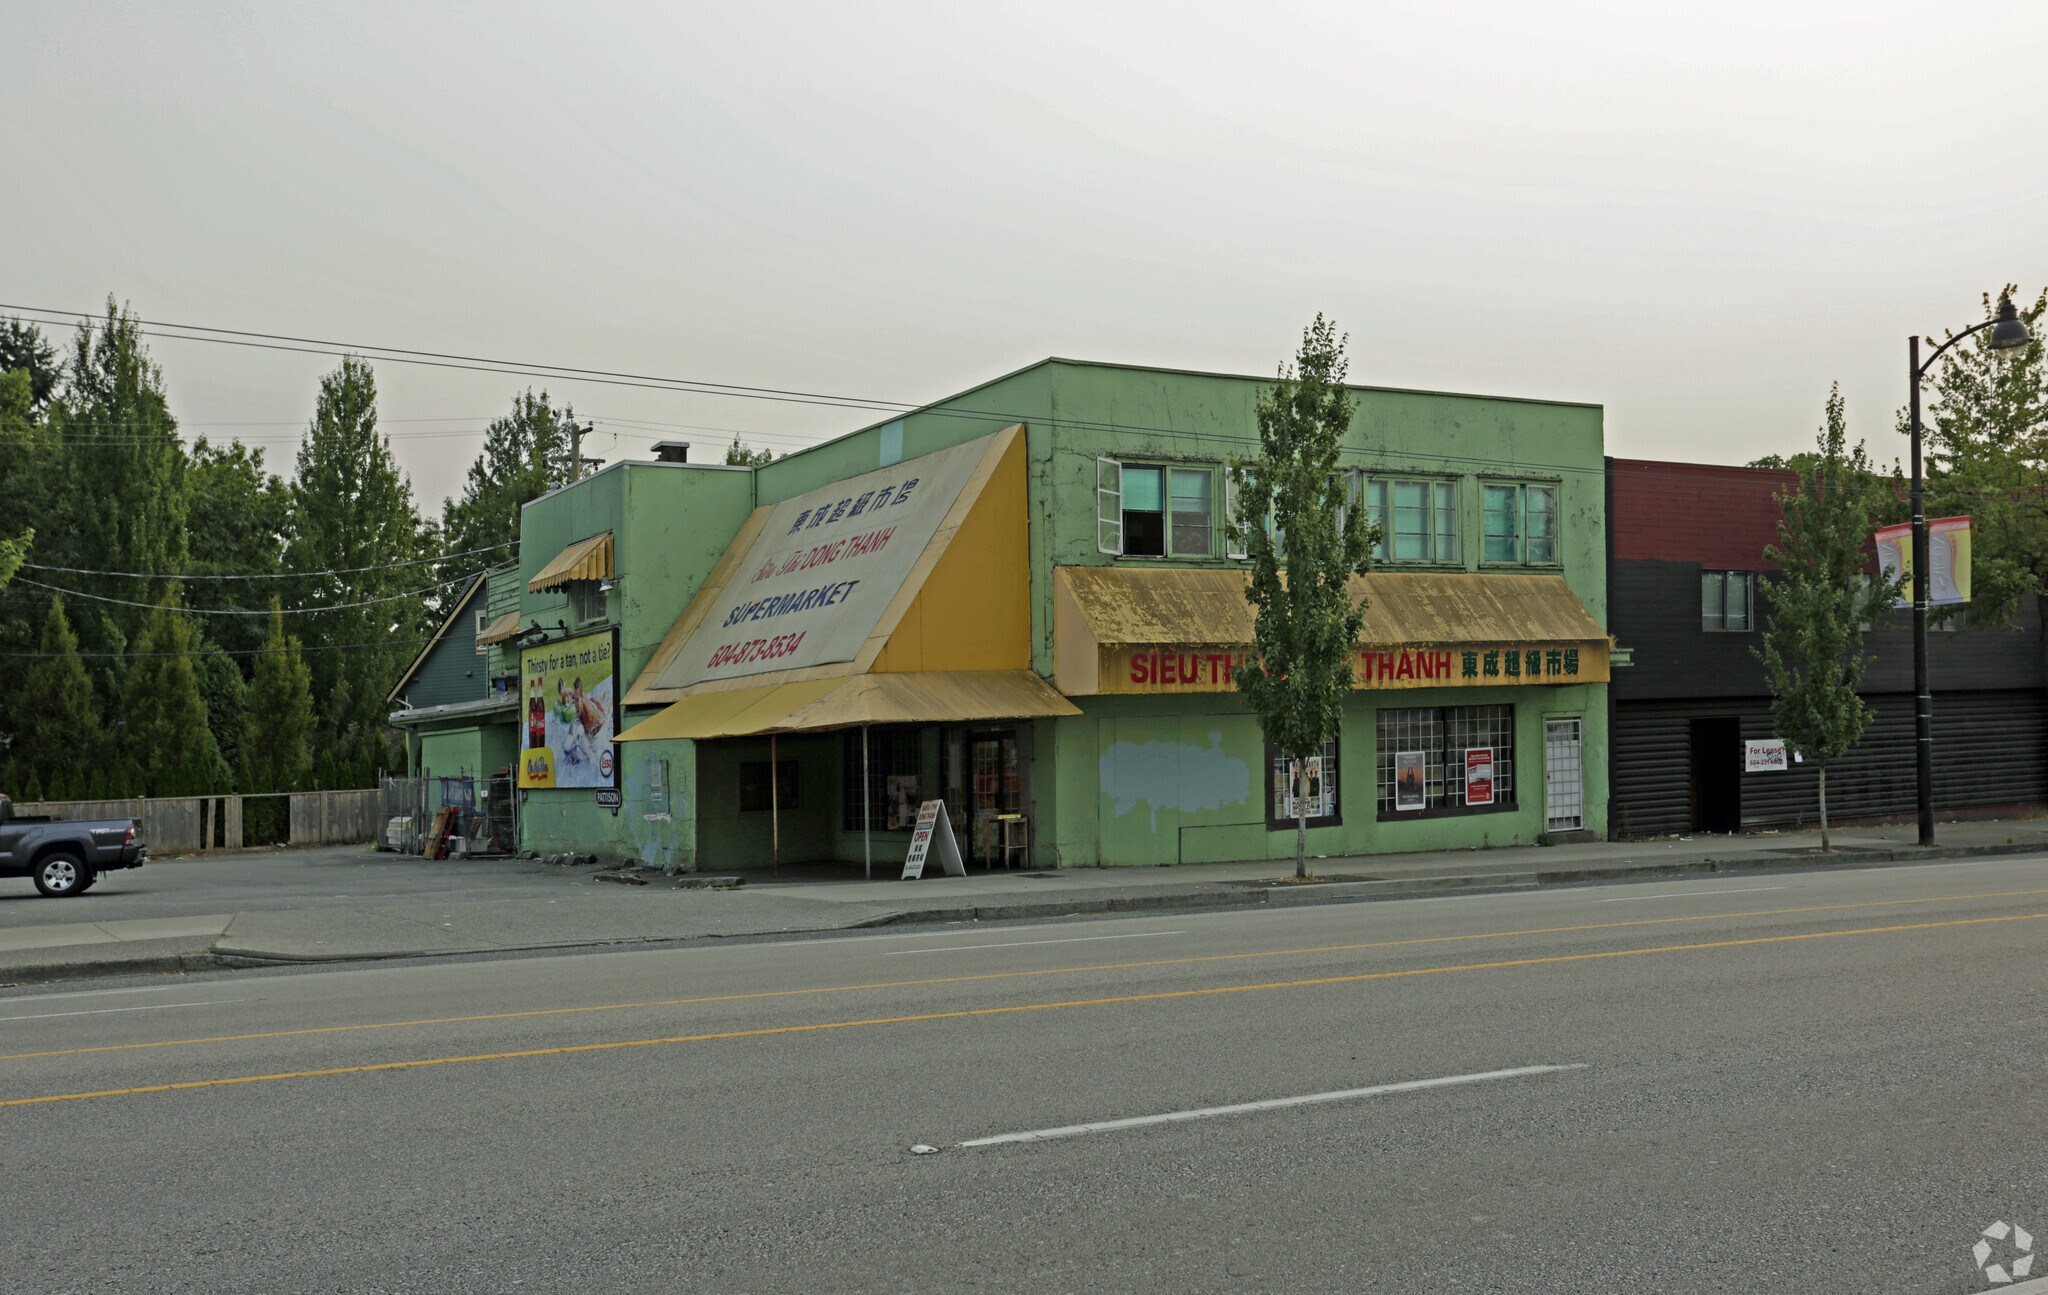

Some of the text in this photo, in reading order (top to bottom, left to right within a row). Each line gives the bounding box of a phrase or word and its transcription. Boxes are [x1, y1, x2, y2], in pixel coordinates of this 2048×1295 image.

[723, 580, 860, 628] SUPERMARKET
[527, 642, 611, 676] Thirsty for a tan, not a tie?
[707, 630, 807, 669] 604-873-8534
[1750, 747, 1761, 755] For
[597, 792, 619, 803] PATTISON
[914, 831, 930, 842] OPEN
